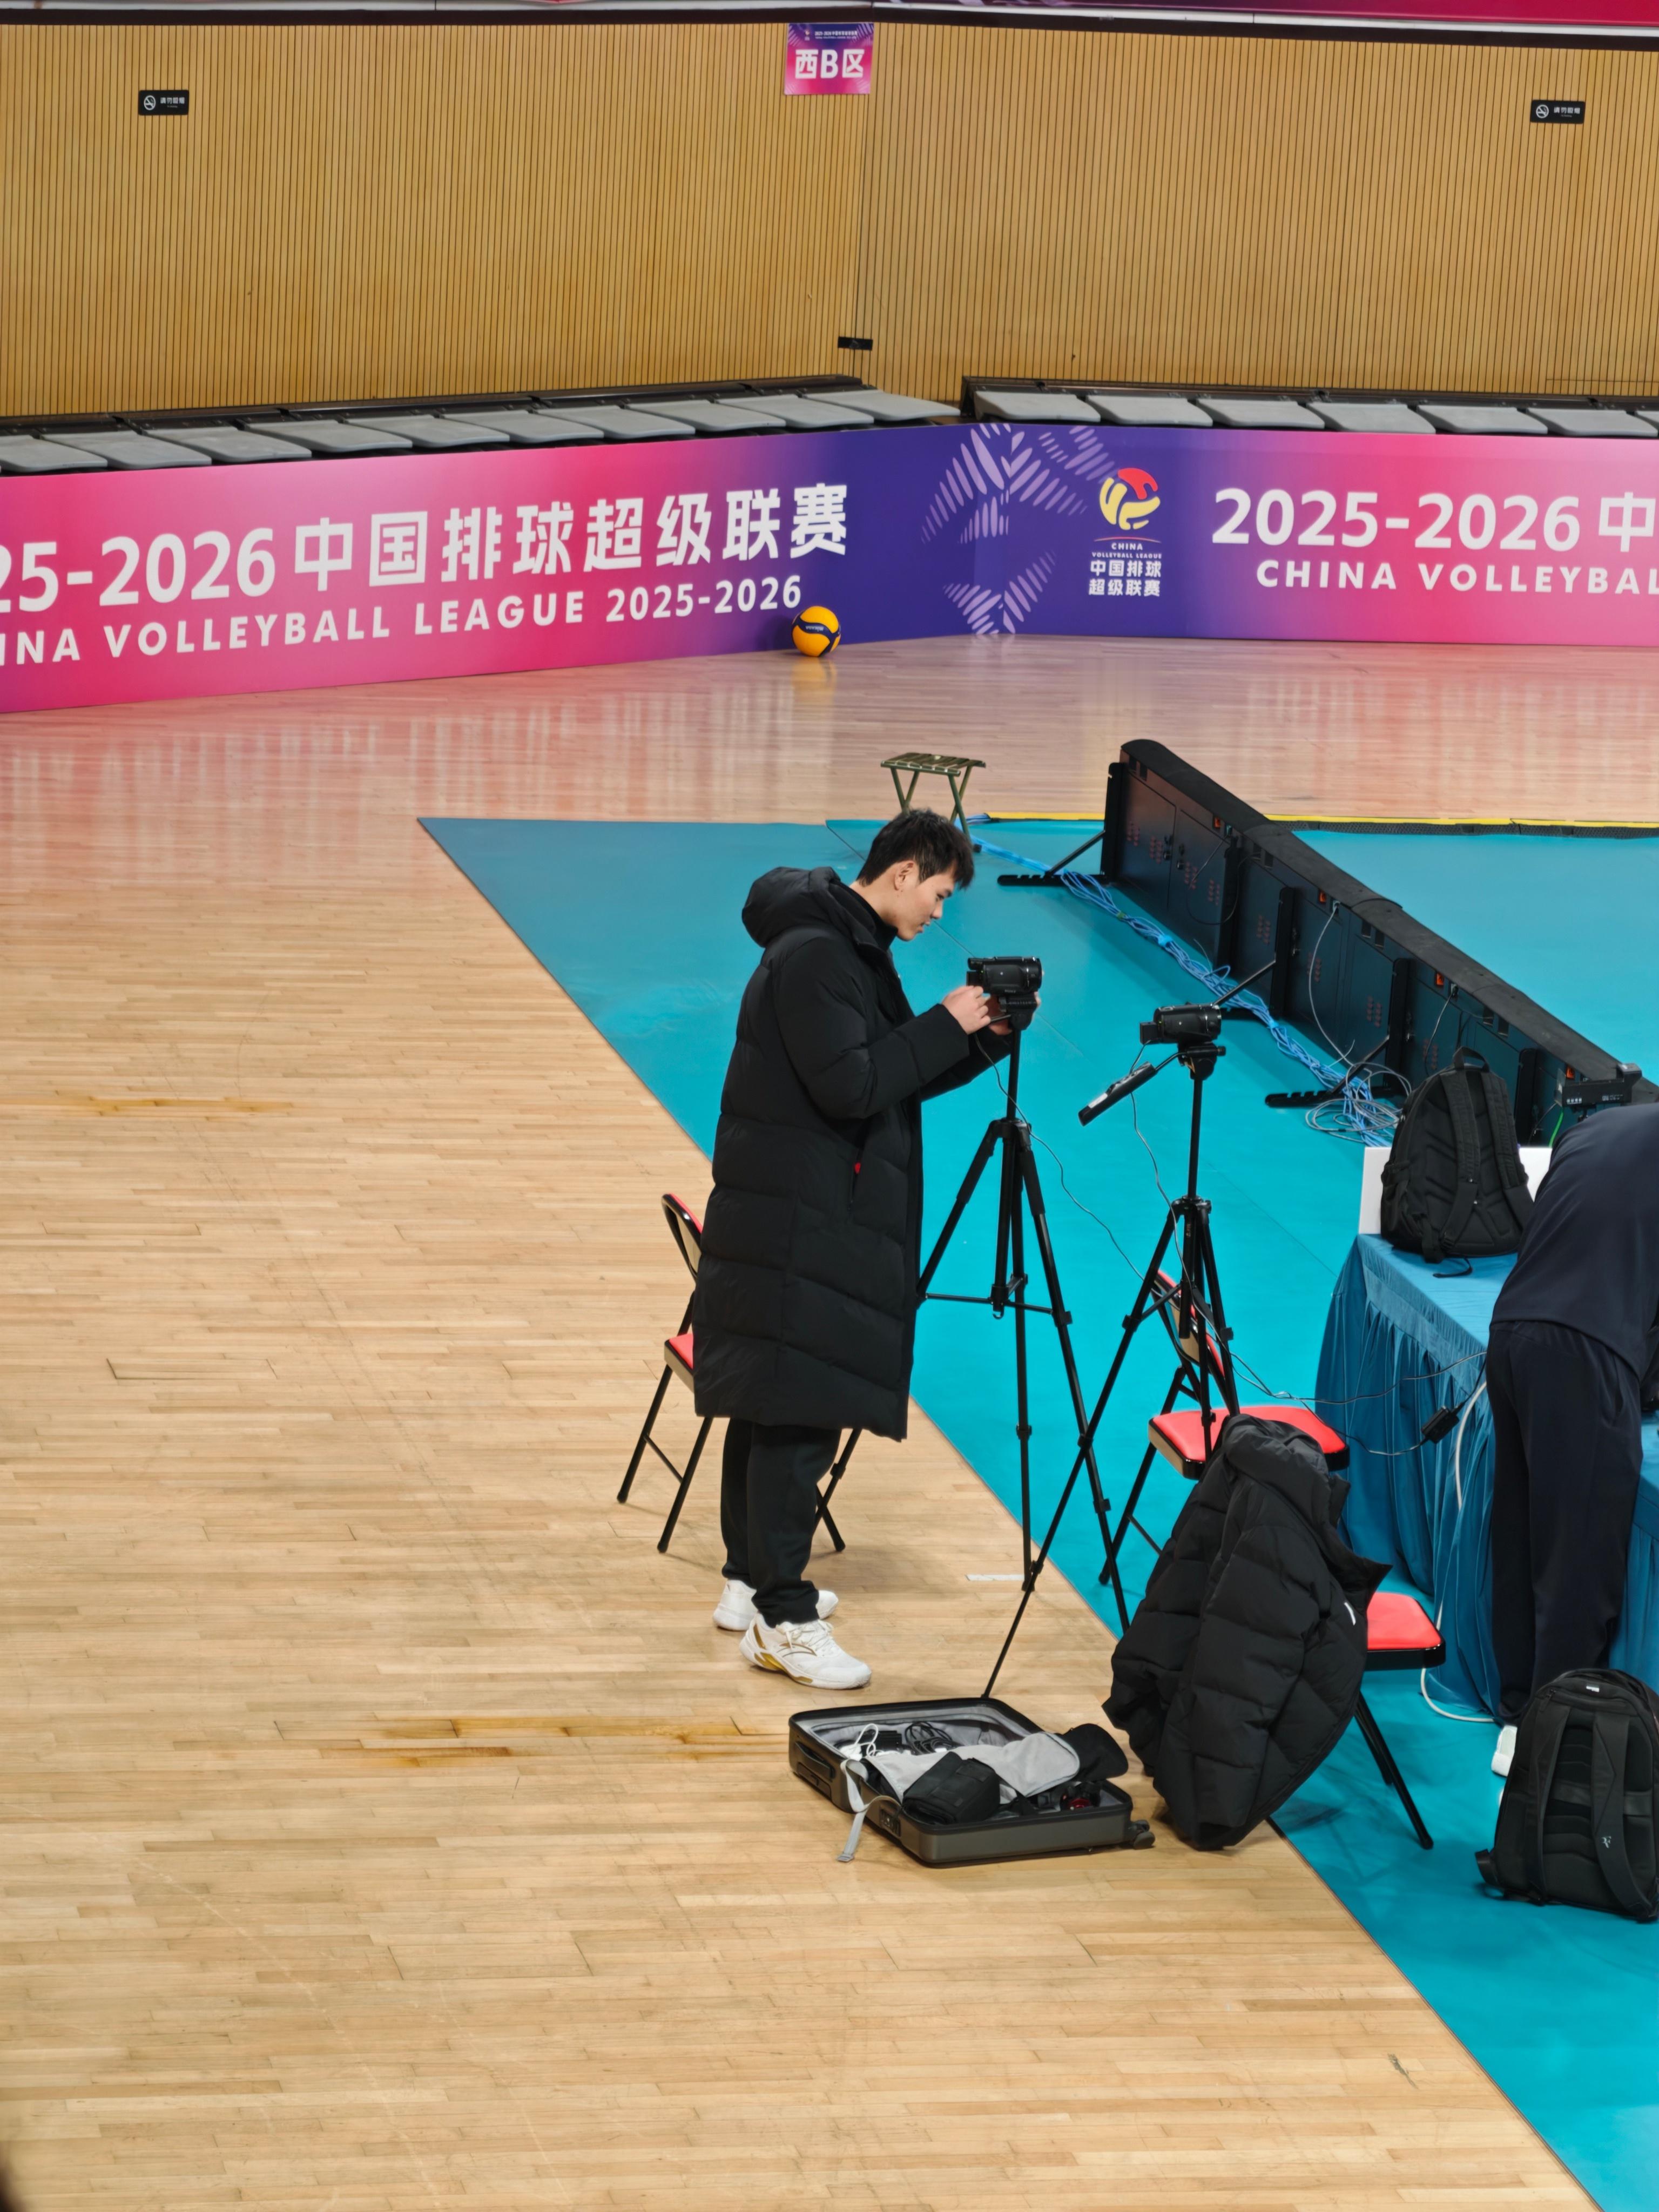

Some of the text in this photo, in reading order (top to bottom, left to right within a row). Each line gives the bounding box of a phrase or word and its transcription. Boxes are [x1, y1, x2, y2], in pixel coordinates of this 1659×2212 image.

[795, 49, 865, 79] 西B区
[1212, 488, 1580, 551] 2025-2026
[1111, 542, 1143, 551] CHINA
[0, 528, 275, 613] 5-2026
[1090, 559, 1162, 577] 中国排球
[1257, 560, 1659, 595] CHINA VOLLEYBAL
[1089, 578, 1161, 597] 超级联赛
[104, 606, 389, 657] VOLLEYBALL
[415, 591, 583, 635] LEAGUE
[606, 575, 800, 622] 2025-2026
